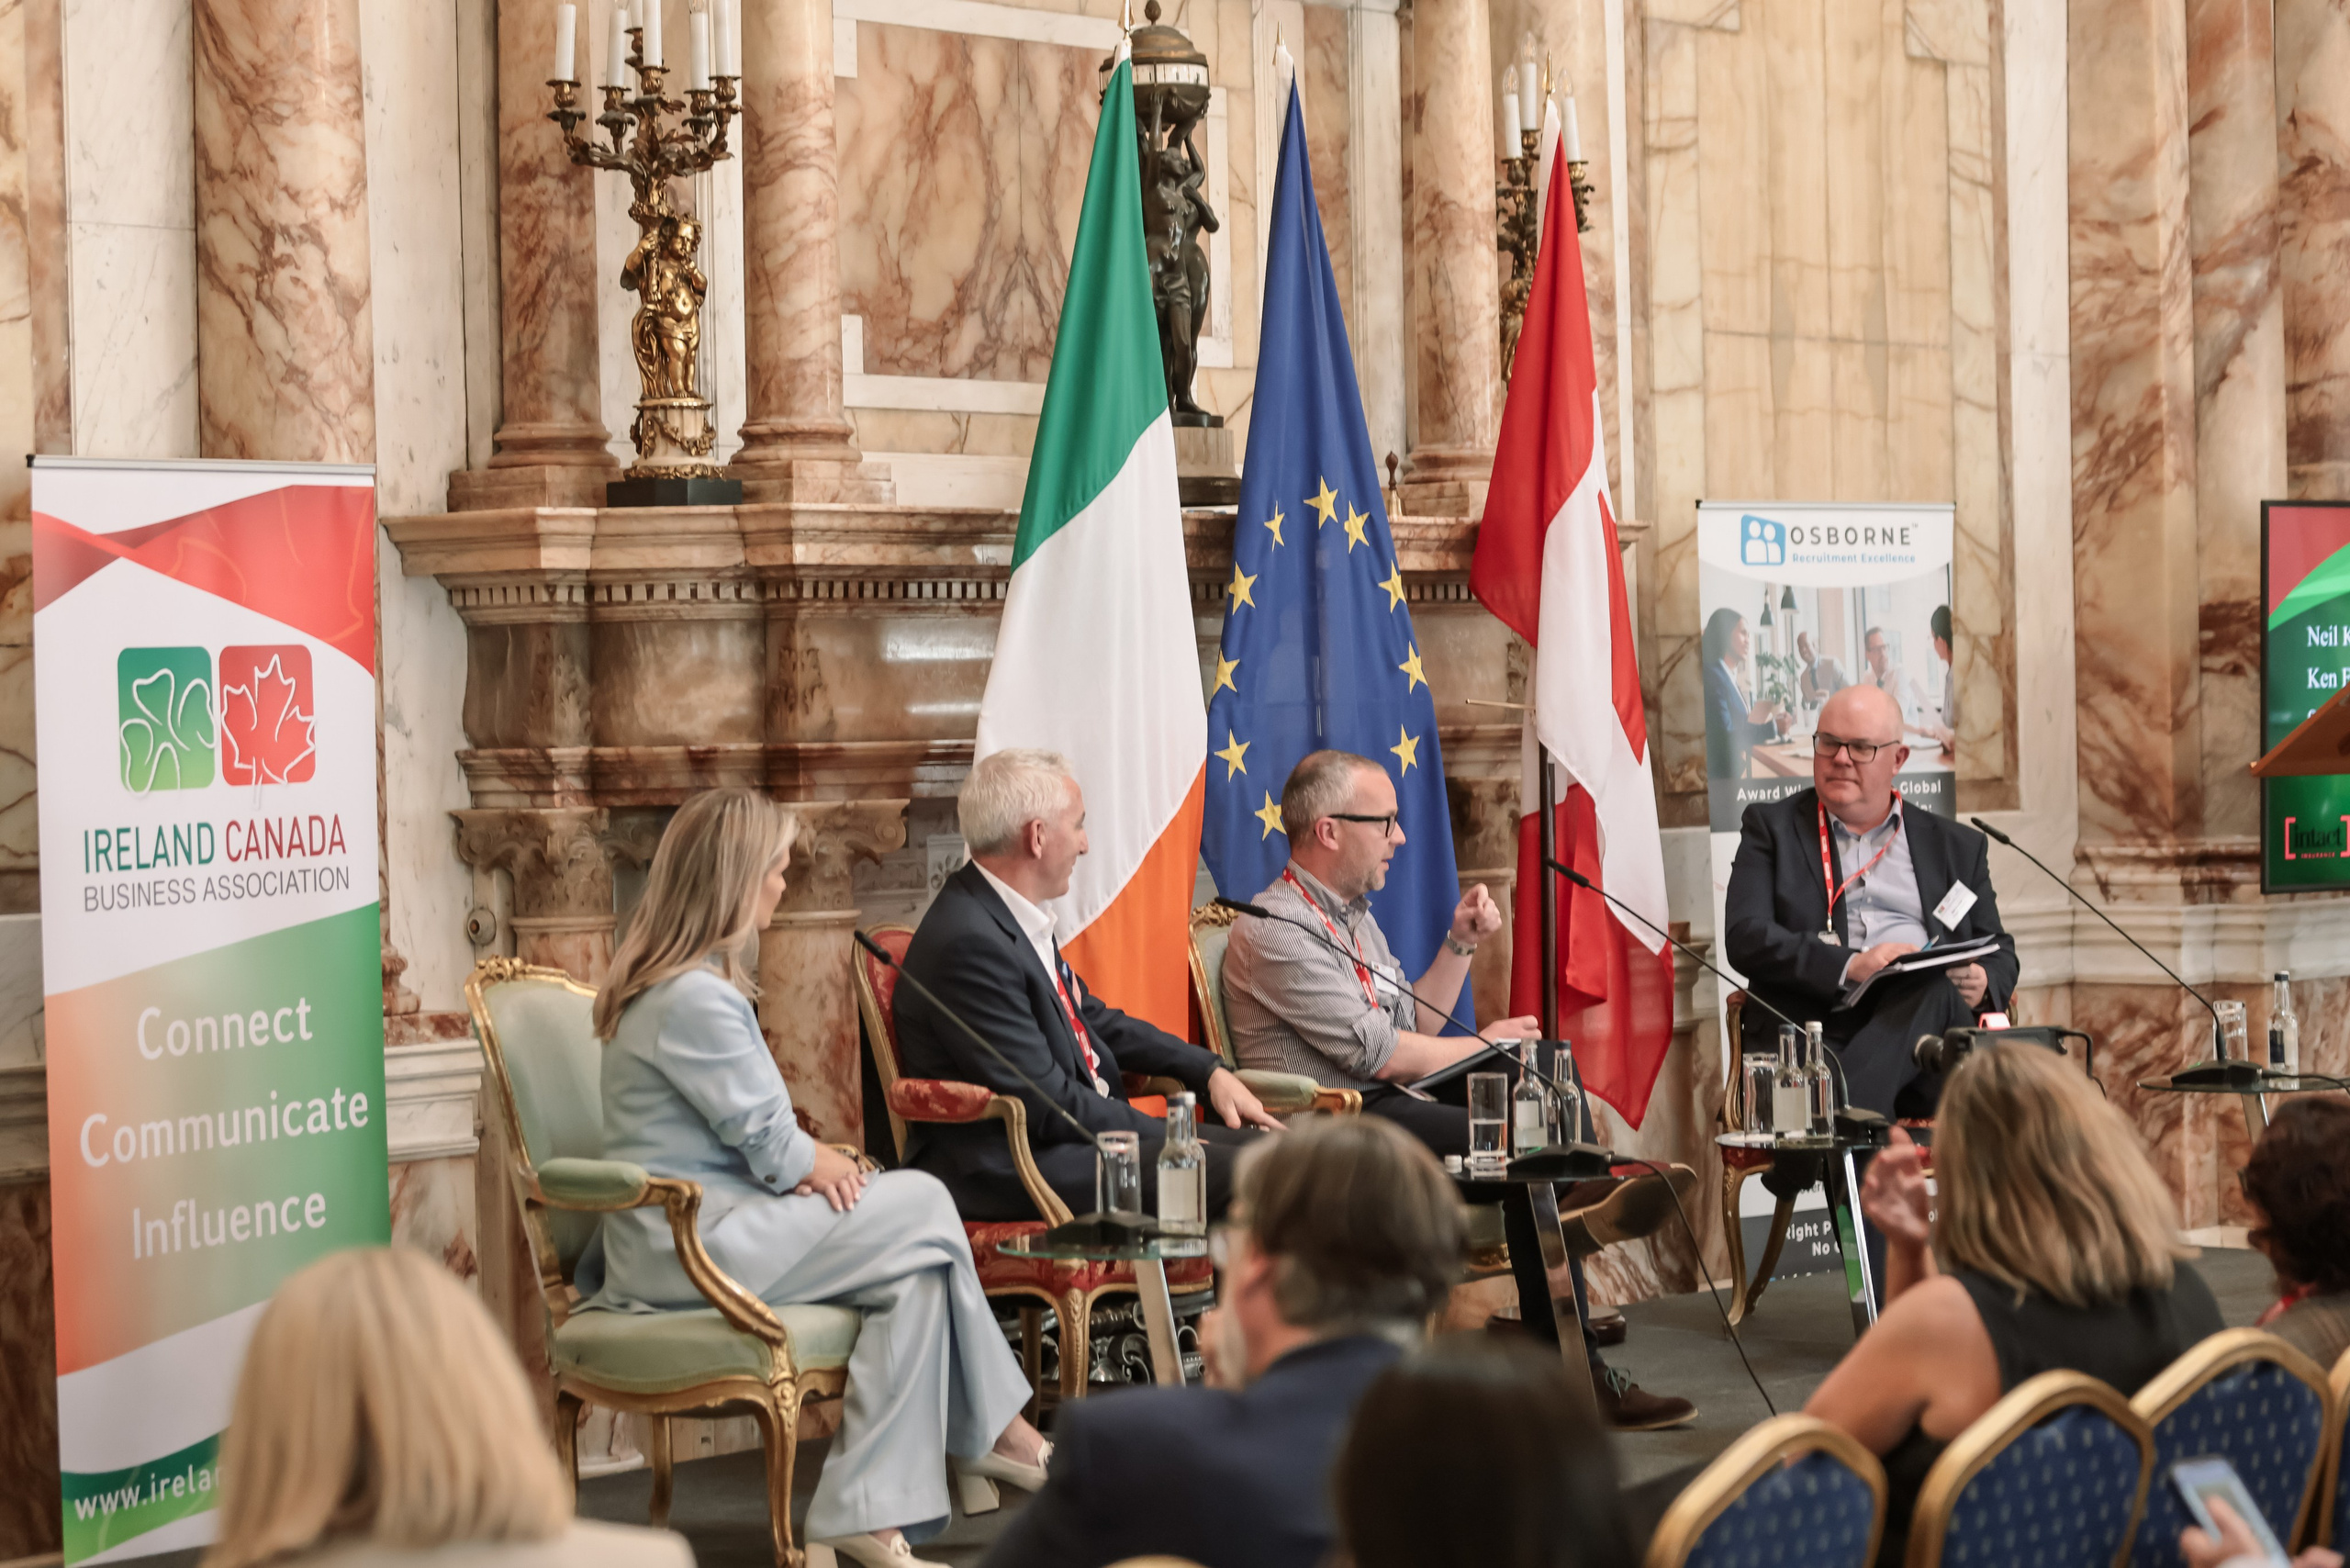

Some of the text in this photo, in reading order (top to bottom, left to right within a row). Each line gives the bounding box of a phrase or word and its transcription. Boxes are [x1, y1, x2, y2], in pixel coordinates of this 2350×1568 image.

[1790, 526, 1910, 545] OSBORNE
[1793, 553, 1916, 563] Recruitment Excellence
[2306, 624, 2338, 647] Neil
[2307, 666, 2338, 689] Ken
[1737, 785, 1781, 801] Award
[1900, 779, 1942, 795] Global
[84, 813, 347, 874] IRELAND CANADA
[84, 866, 350, 913] BUSINESS ASSOCIATION
[138, 997, 313, 1060] Connect
[80, 1087, 369, 1168] Communicate
[133, 1193, 327, 1260] Influence
[1811, 1241, 1830, 1257] No
